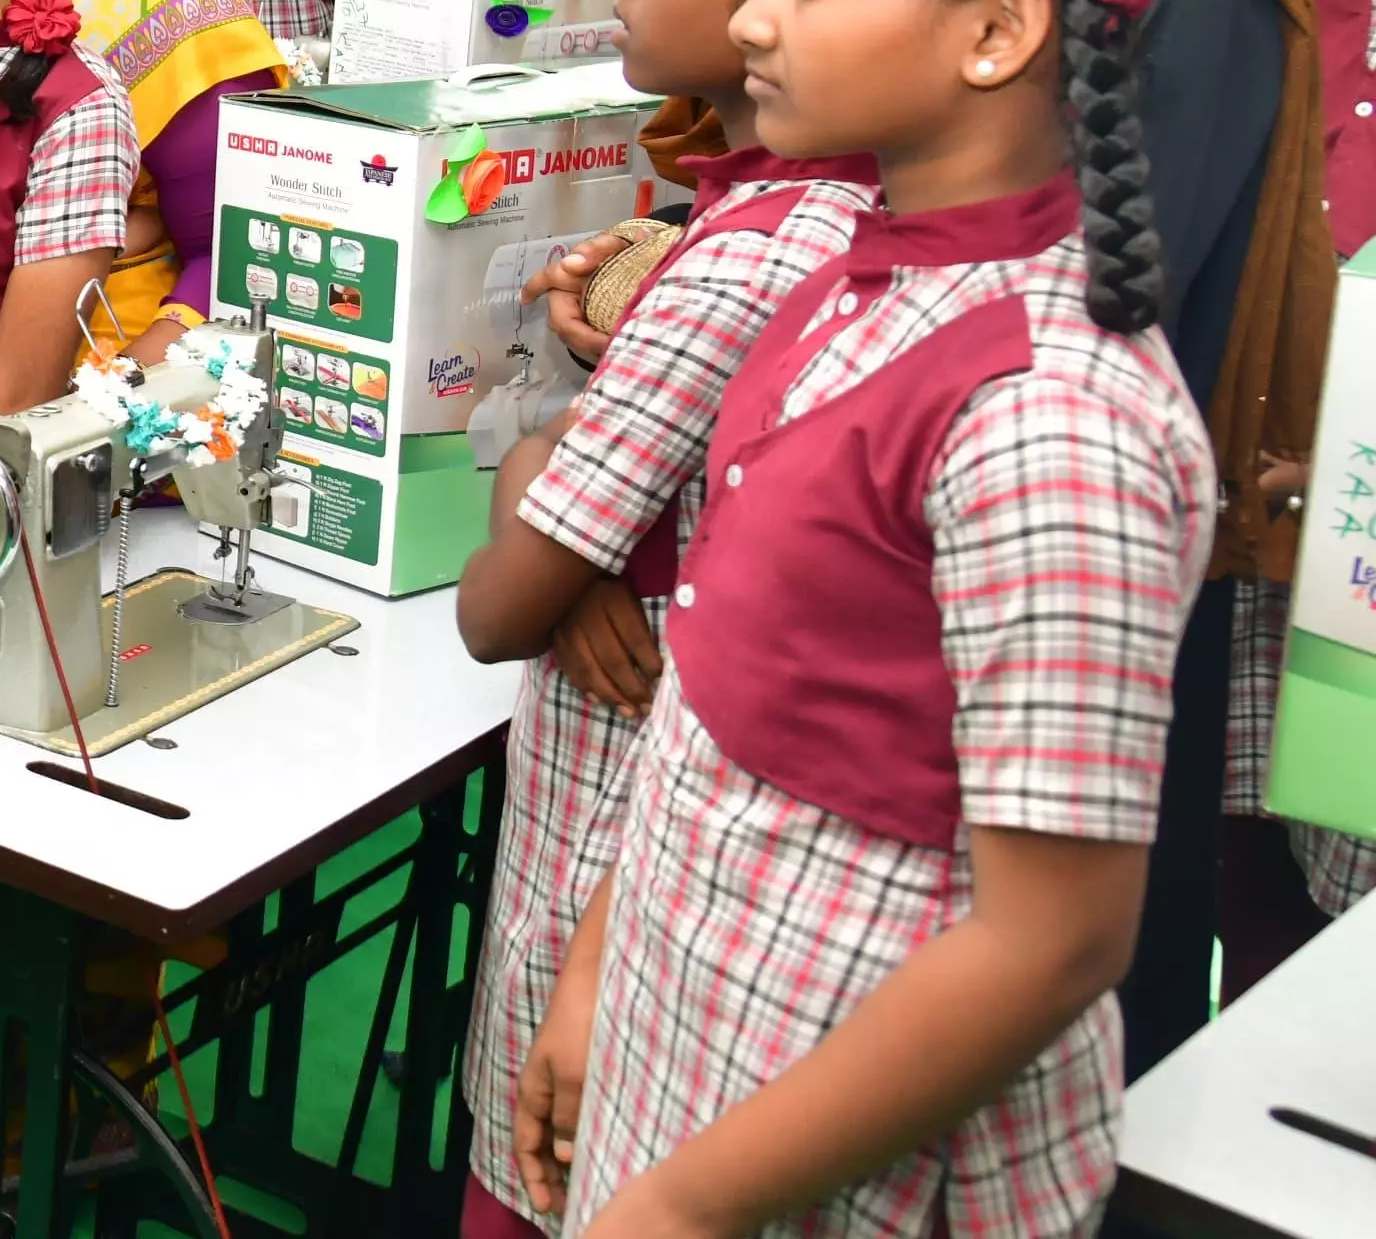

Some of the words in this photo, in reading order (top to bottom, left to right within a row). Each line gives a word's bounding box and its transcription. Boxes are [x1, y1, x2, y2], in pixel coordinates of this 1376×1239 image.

[228, 132, 278, 157] USHA
[281, 145, 333, 165] JANOME
[539, 143, 627, 176] JANOME
[270, 173, 308, 193] Wonder
[312, 182, 342, 199] Stitch
[491, 193, 519, 210] Stitch
[478, 217, 499, 227] Sewing
[500, 215, 525, 224] Machine
[428, 355, 463, 383] Learn
[437, 366, 475, 391] Create
